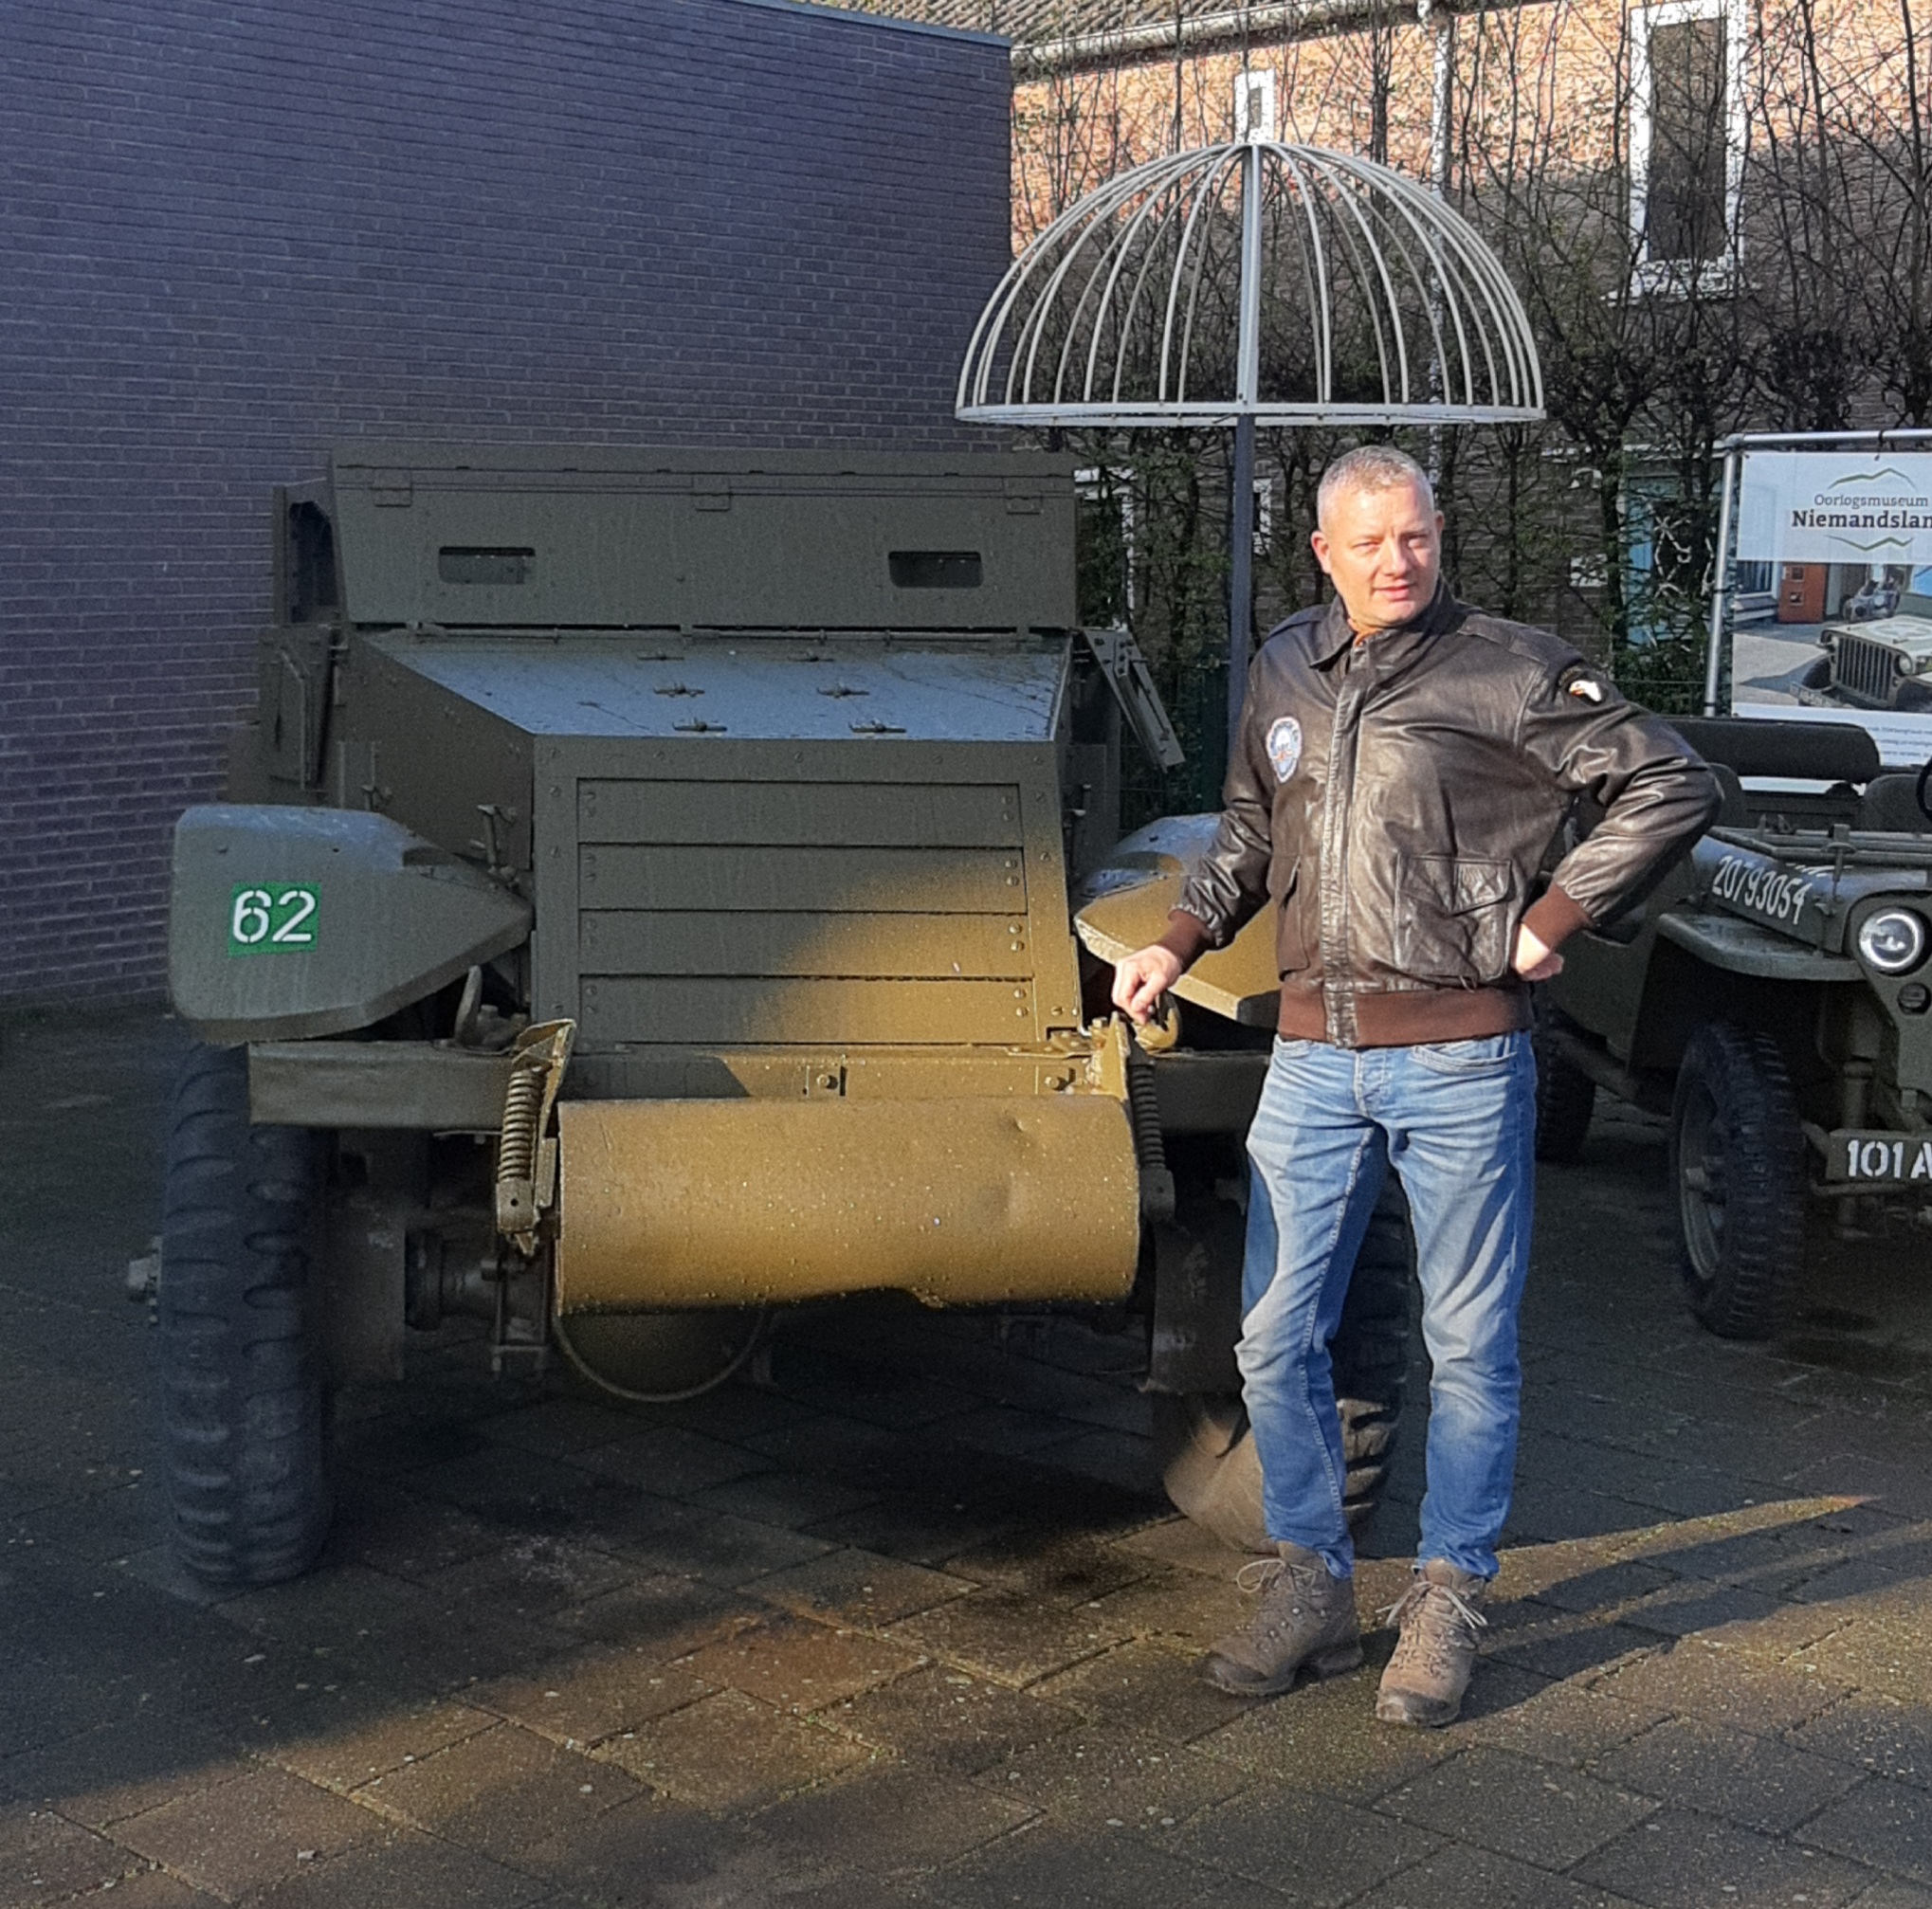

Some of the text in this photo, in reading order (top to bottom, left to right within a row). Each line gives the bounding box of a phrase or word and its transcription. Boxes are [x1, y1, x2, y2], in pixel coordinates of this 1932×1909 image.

[1814, 494, 1928, 509] Oorlogsmuseum
[1712, 855, 1813, 925] 20793054
[233, 889, 316, 943] 62
[1848, 1139, 1904, 1178] 101
